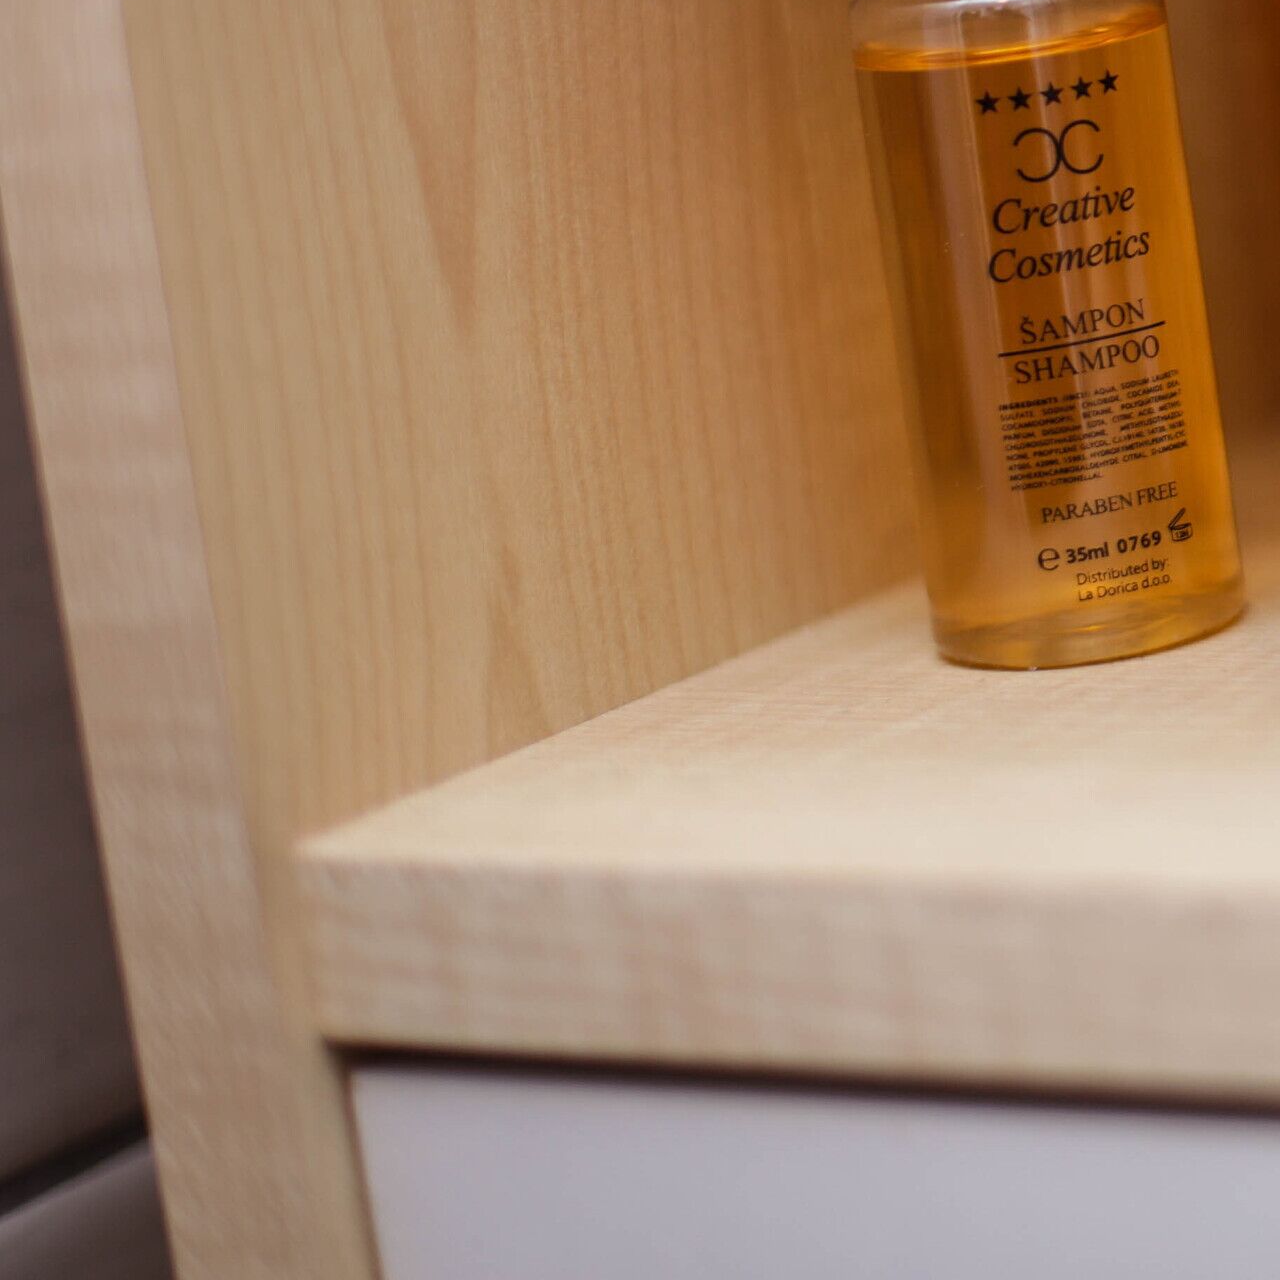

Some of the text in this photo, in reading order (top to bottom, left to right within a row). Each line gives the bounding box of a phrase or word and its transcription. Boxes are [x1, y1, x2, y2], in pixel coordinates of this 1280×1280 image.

[993, 186, 1135, 234] Creative
[989, 231, 1150, 283] Cosmetics
[1020, 298, 1144, 345] ŠAMPON
[1014, 335, 1160, 384] SHAMPOO
[1042, 481, 1178, 523] PARABEN FREE
[1066, 542, 1109, 564] 35ml
[1117, 531, 1162, 554] 0769
[1077, 560, 1149, 585] Distributed
[1078, 588, 1094, 601] La
[1098, 581, 1139, 598] Dorica
